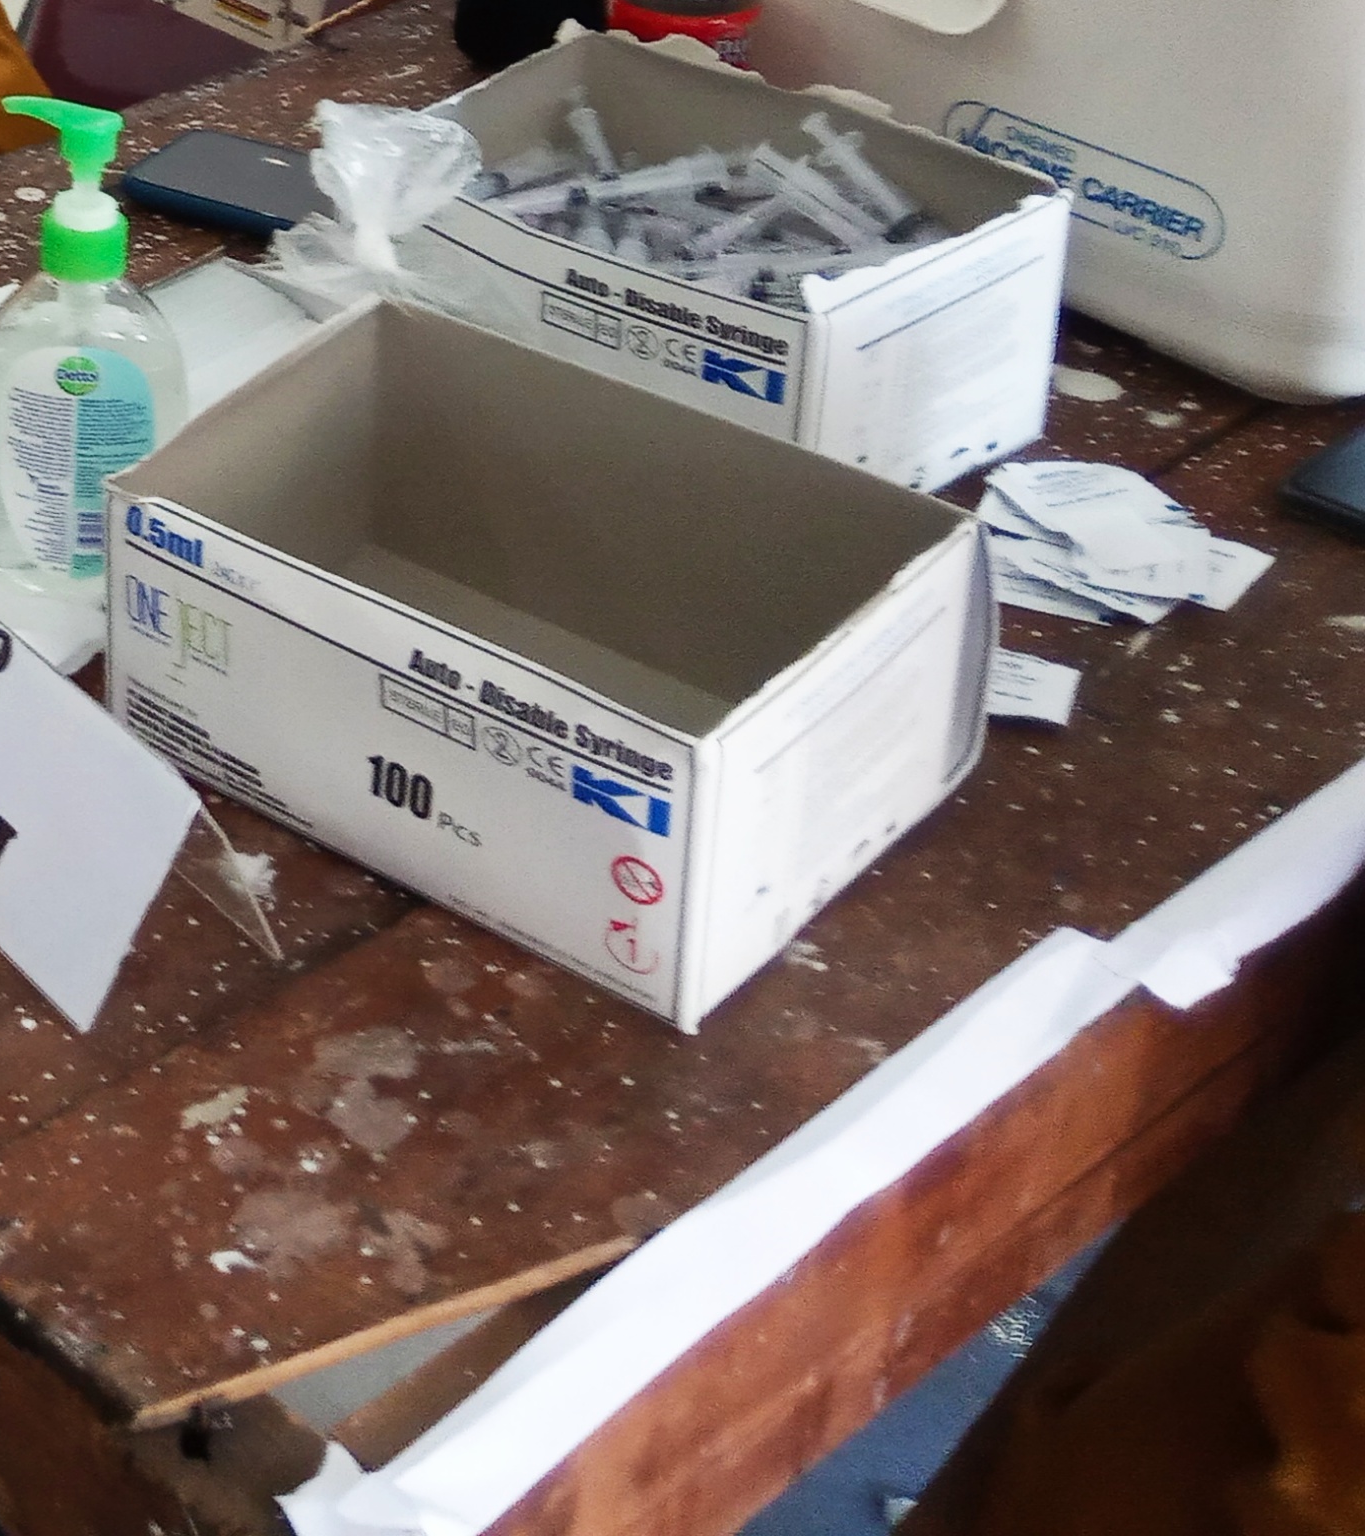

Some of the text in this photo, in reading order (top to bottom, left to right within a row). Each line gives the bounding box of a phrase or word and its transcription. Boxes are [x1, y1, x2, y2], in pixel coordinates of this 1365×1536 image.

[1081, 177, 1205, 241] CARRIER
[566, 268, 610, 298] Auto
[625, 288, 704, 330] Disable
[705, 315, 789, 356] Syringe
[126, 505, 204, 568] 0.5ml
[408, 648, 462, 690] Auto
[478, 680, 569, 740] Disable
[574, 723, 674, 781] Syringe
[367, 754, 434, 821] 100
